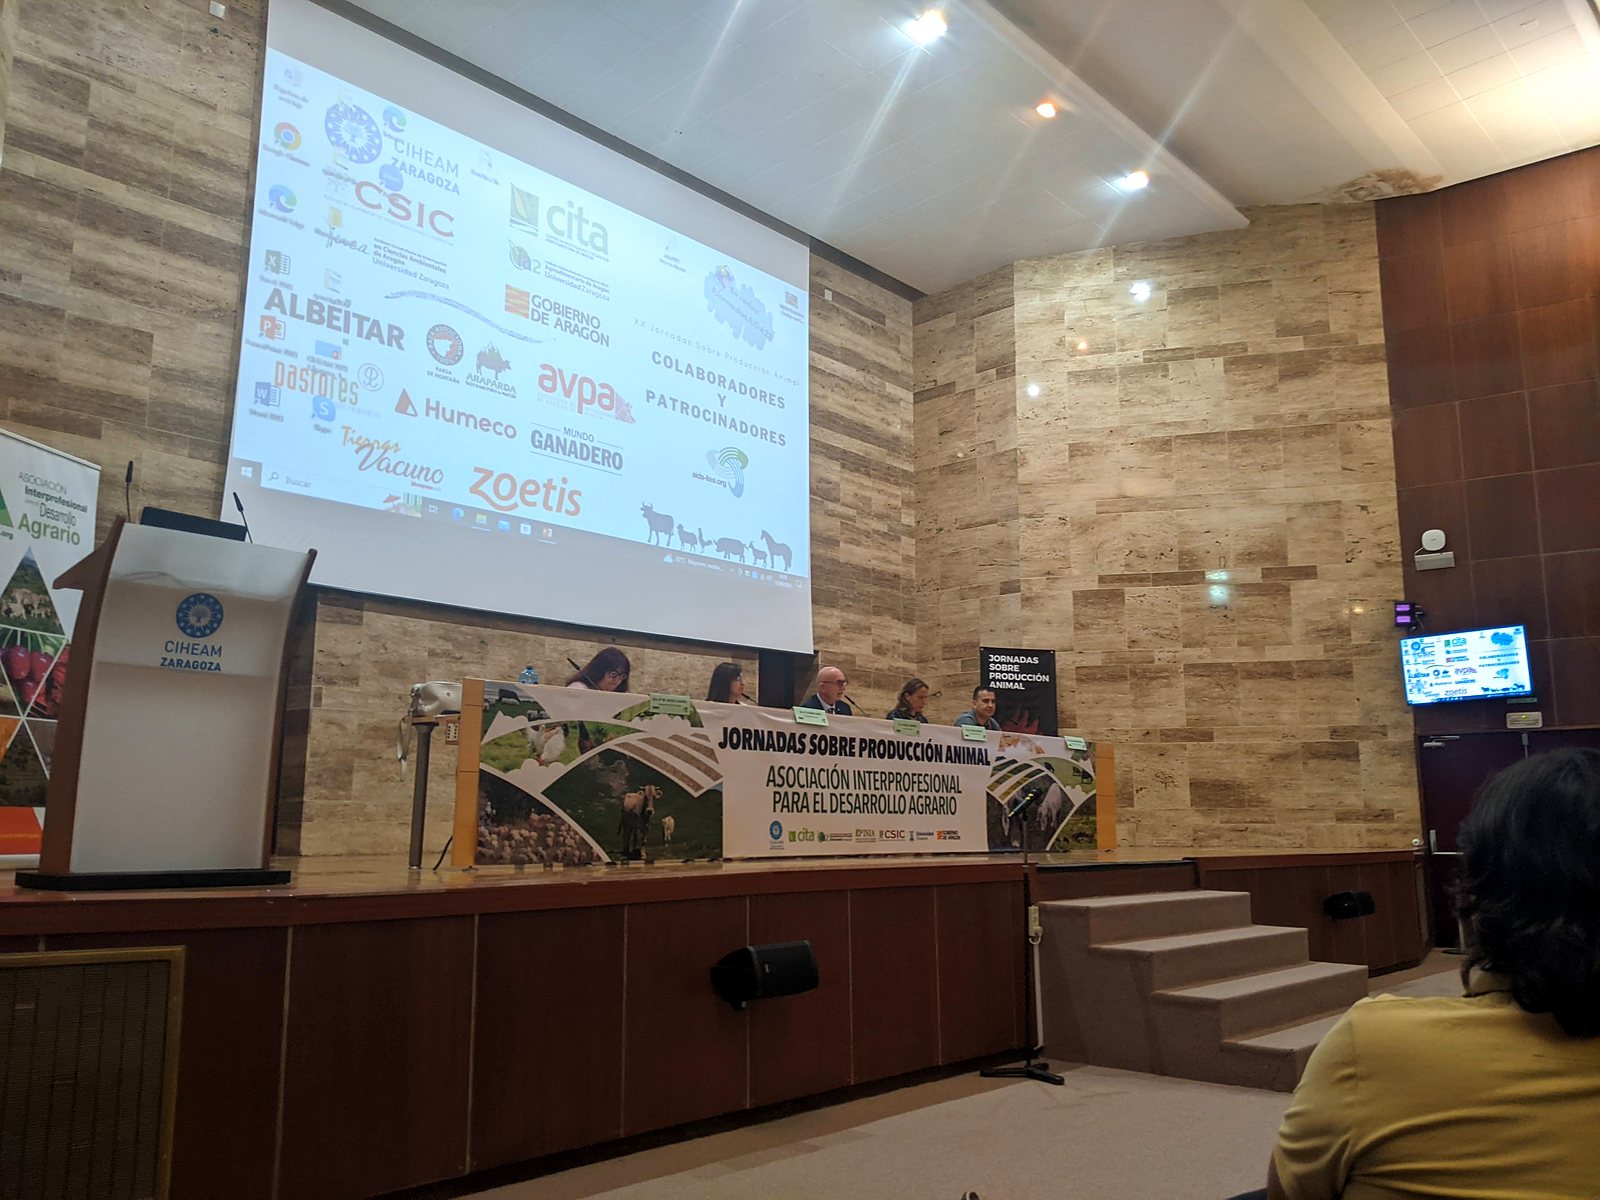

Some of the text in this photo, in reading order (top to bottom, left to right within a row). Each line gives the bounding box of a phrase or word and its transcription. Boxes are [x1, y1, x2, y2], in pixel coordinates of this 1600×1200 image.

[394, 138, 459, 178] CIHEAM
[391, 156, 460, 195] ZARAGOZA
[355, 180, 455, 238] CSIC
[547, 200, 609, 255] cita
[264, 287, 405, 351] ALBEITAR
[531, 294, 601, 329] GOBIERNO
[531, 308, 610, 348] DE ARAGON
[466, 372, 517, 394] ARAPARDA
[538, 363, 615, 414] avpa
[651, 350, 786, 410] COLABORADORES
[717, 393, 726, 408] Y
[425, 398, 518, 439] Humeco
[645, 389, 787, 446] PATROCINADORES
[530, 429, 624, 471] GANADERO
[563, 426, 594, 443] MUNDO
[354, 443, 445, 485] Vacuno
[285, 475, 312, 488] Buscar
[469, 466, 583, 517] zoetis
[24, 486, 88, 513] Interprofesional
[18, 513, 80, 545] Agrario
[160, 656, 222, 672] ZARAGOZA
[164, 640, 222, 658] CIHEAM
[988, 654, 1039, 664] JORNADAS
[988, 663, 1020, 672] SOBRE
[989, 672, 1050, 682] PRODUCCIÓN
[989, 681, 1025, 690] ANIMAL
[718, 726, 991, 767] JORNADAS SOBRE PRODUCCIÓN ANIMAL
[766, 763, 962, 794] ASOCIACIÓN INTERPROFESIONAL
[773, 791, 957, 816] PARA EL DESARROLLO AGRARIO
[797, 827, 815, 843] cita
[884, 830, 906, 839] CSIC
